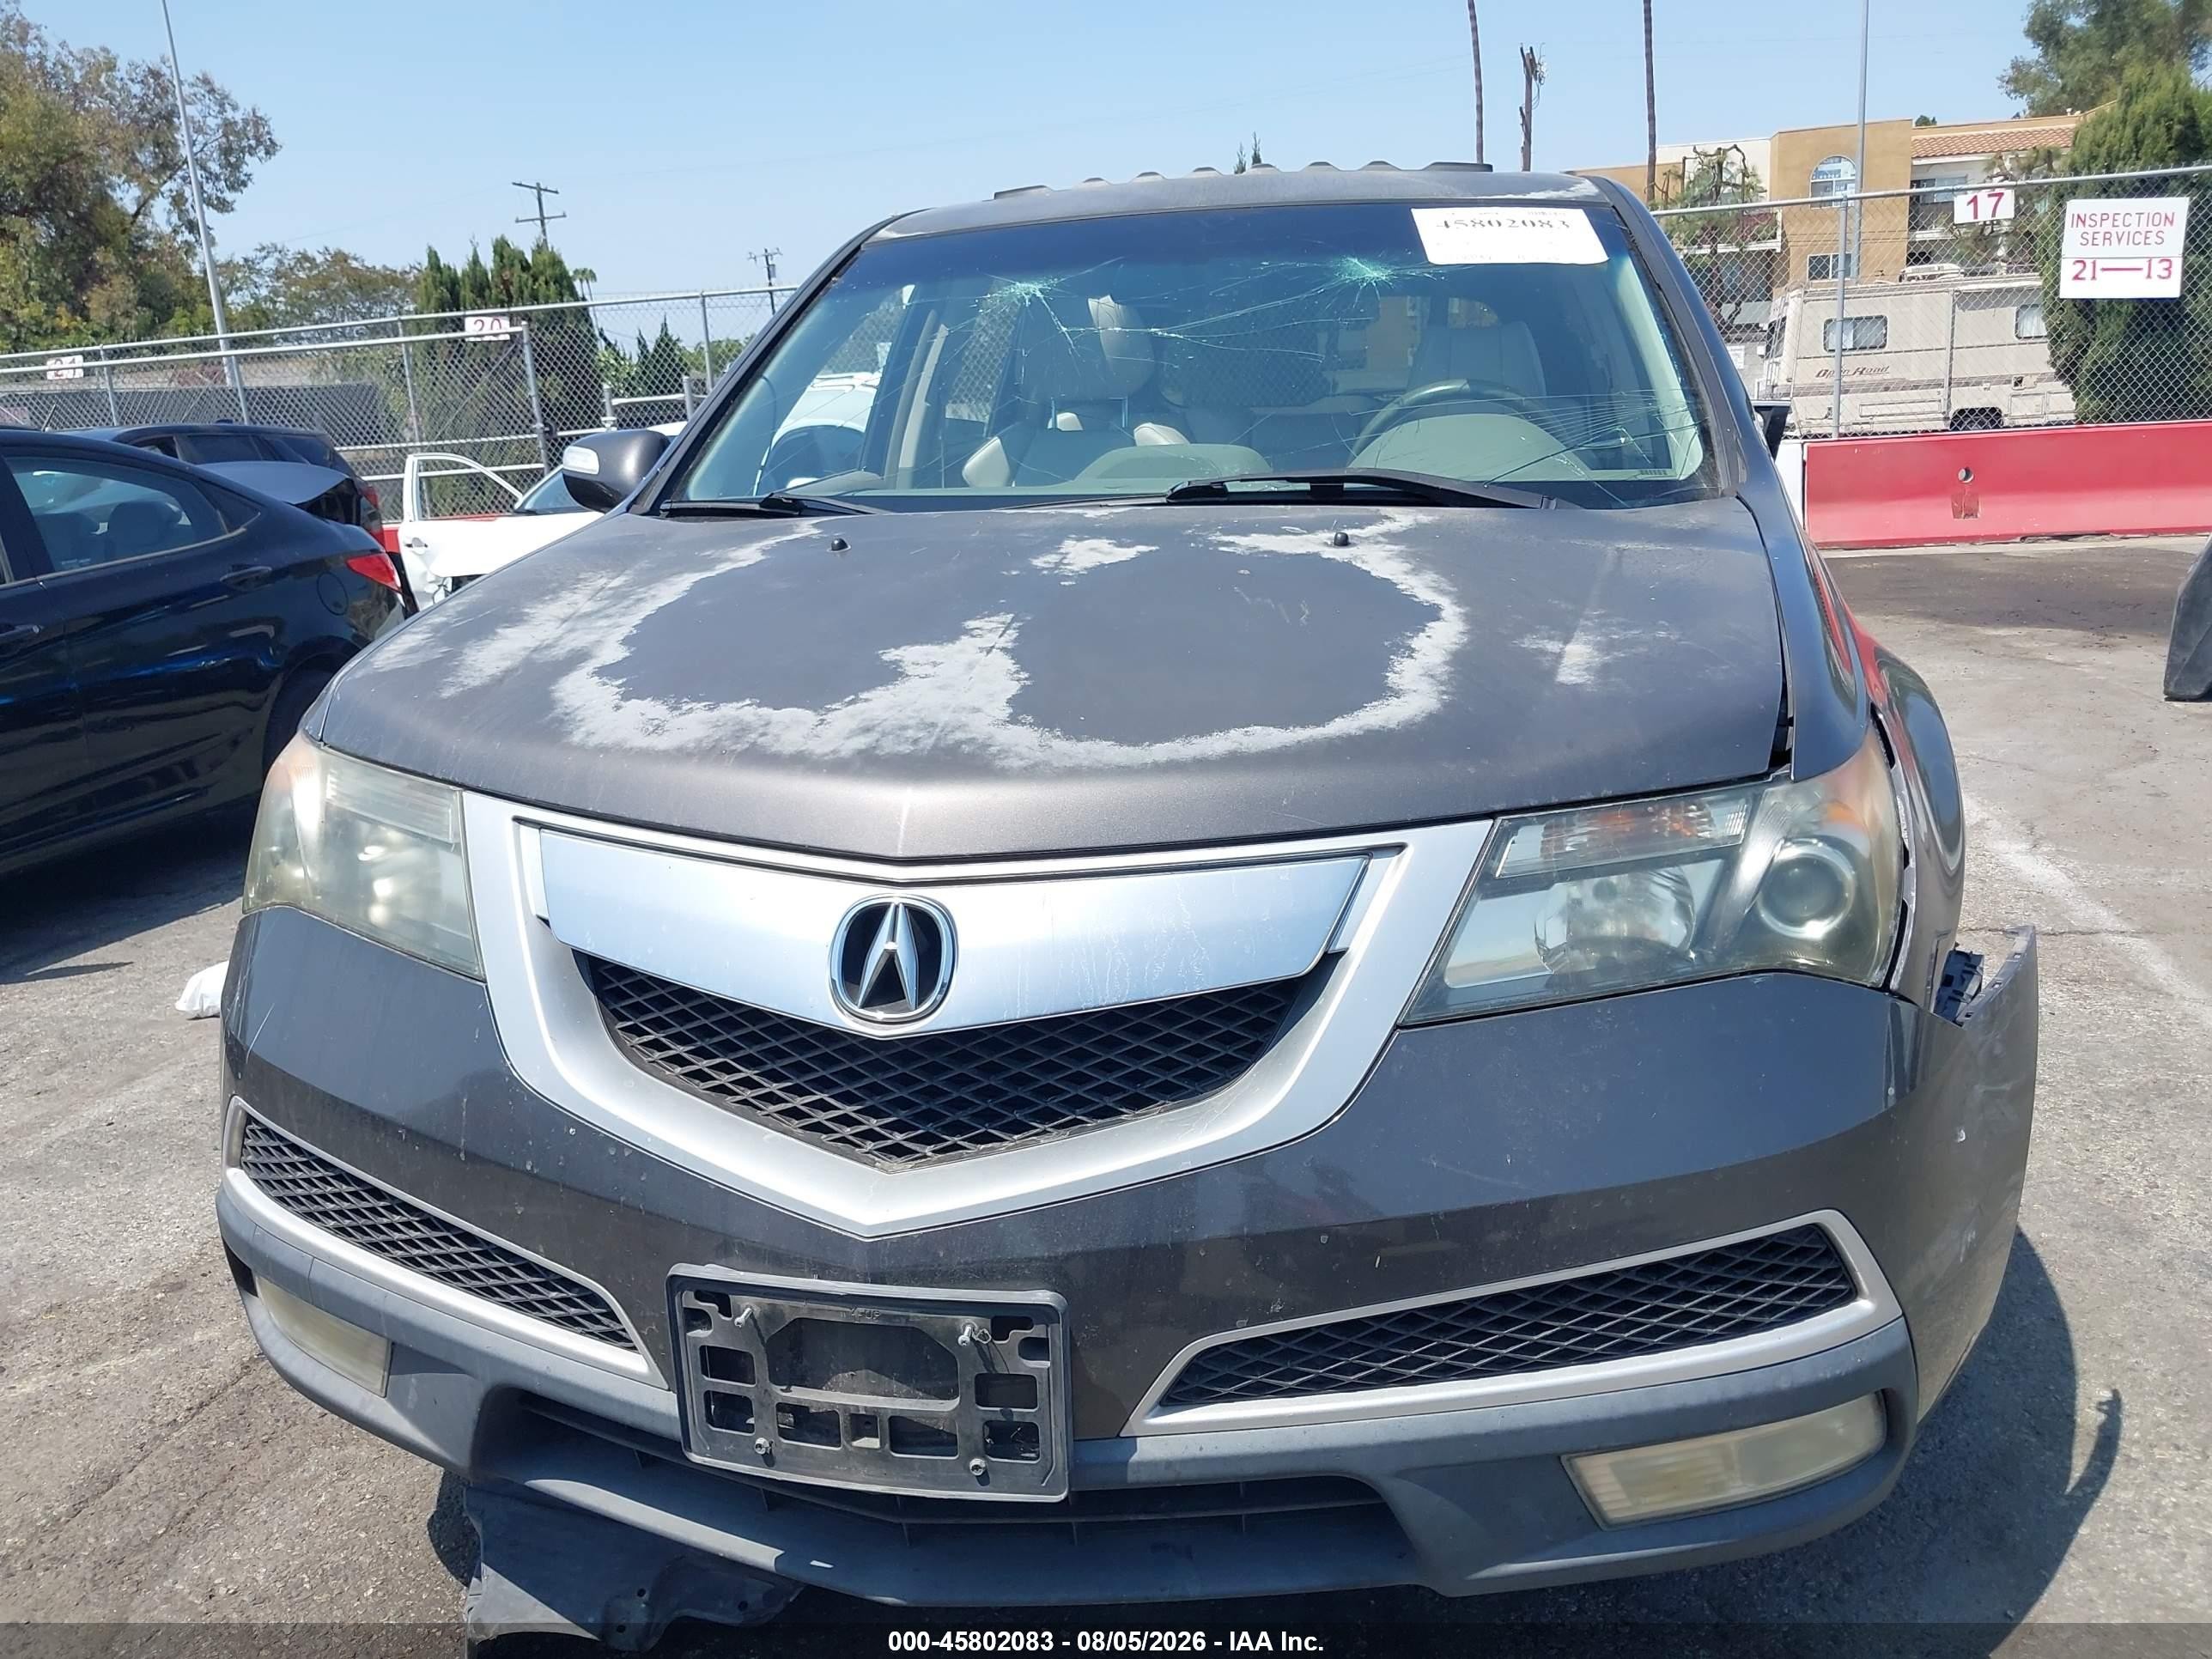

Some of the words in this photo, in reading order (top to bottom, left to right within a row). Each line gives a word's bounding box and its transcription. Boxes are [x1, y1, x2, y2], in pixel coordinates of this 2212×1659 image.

[1966, 191, 2005, 220] 17
[2070, 211, 2176, 228] INSPECTION
[2079, 230, 2166, 246] SERVICES
